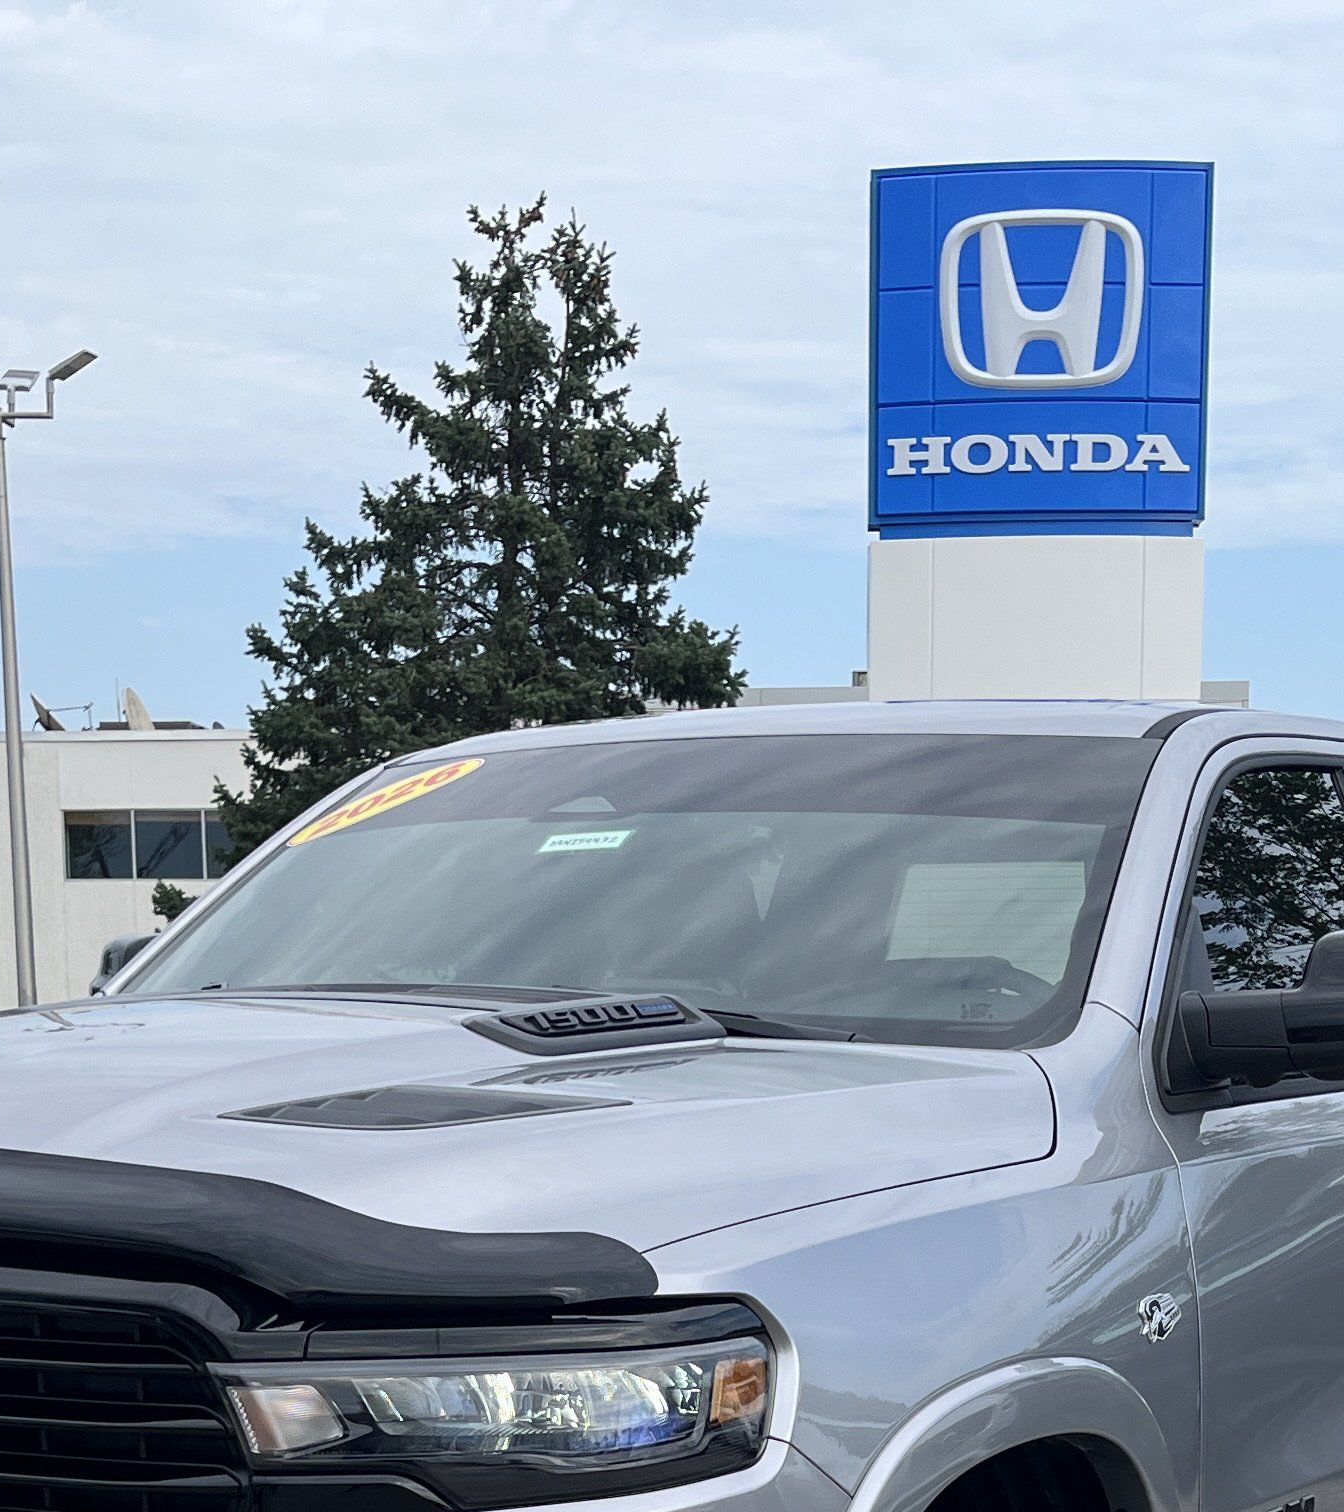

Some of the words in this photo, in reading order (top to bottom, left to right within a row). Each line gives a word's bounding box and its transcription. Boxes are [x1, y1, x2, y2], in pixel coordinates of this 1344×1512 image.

[886, 433, 1191, 477] HONDA
[306, 760, 468, 839] 2026
[523, 1003, 637, 1031] 1500
